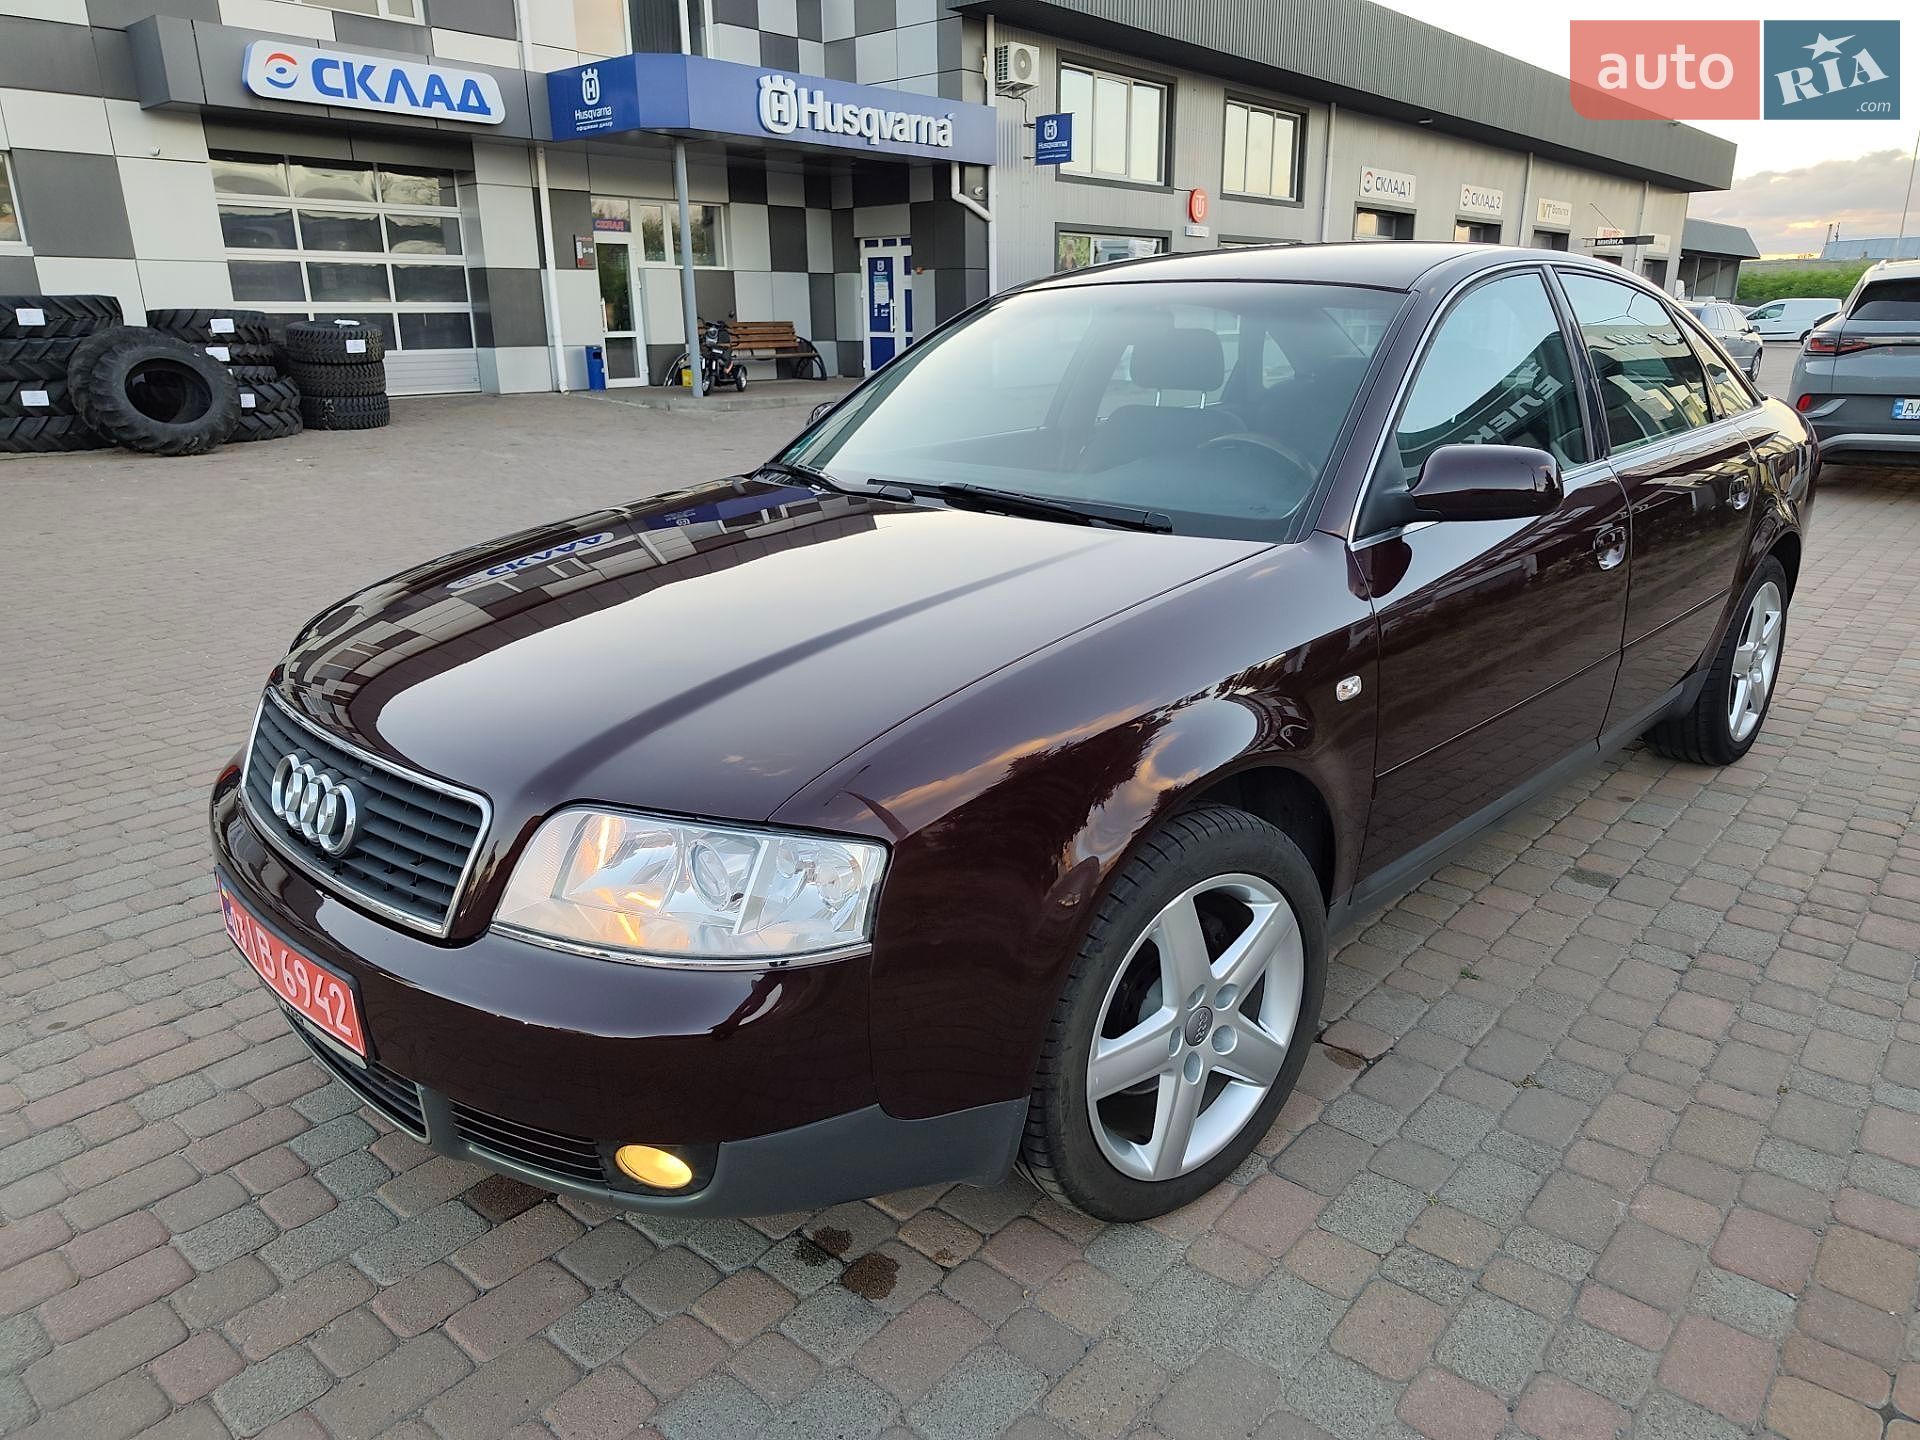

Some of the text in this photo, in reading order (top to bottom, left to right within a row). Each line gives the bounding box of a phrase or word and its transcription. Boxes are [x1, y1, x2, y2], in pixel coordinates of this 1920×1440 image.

[311, 57, 492, 116] СКЛАД
[574, 106, 612, 120] Husqvarna
[798, 87, 953, 148] Husqvarna
[1375, 176, 1406, 197] СКЛАД
[1471, 192, 1496, 210] СКЛАД
